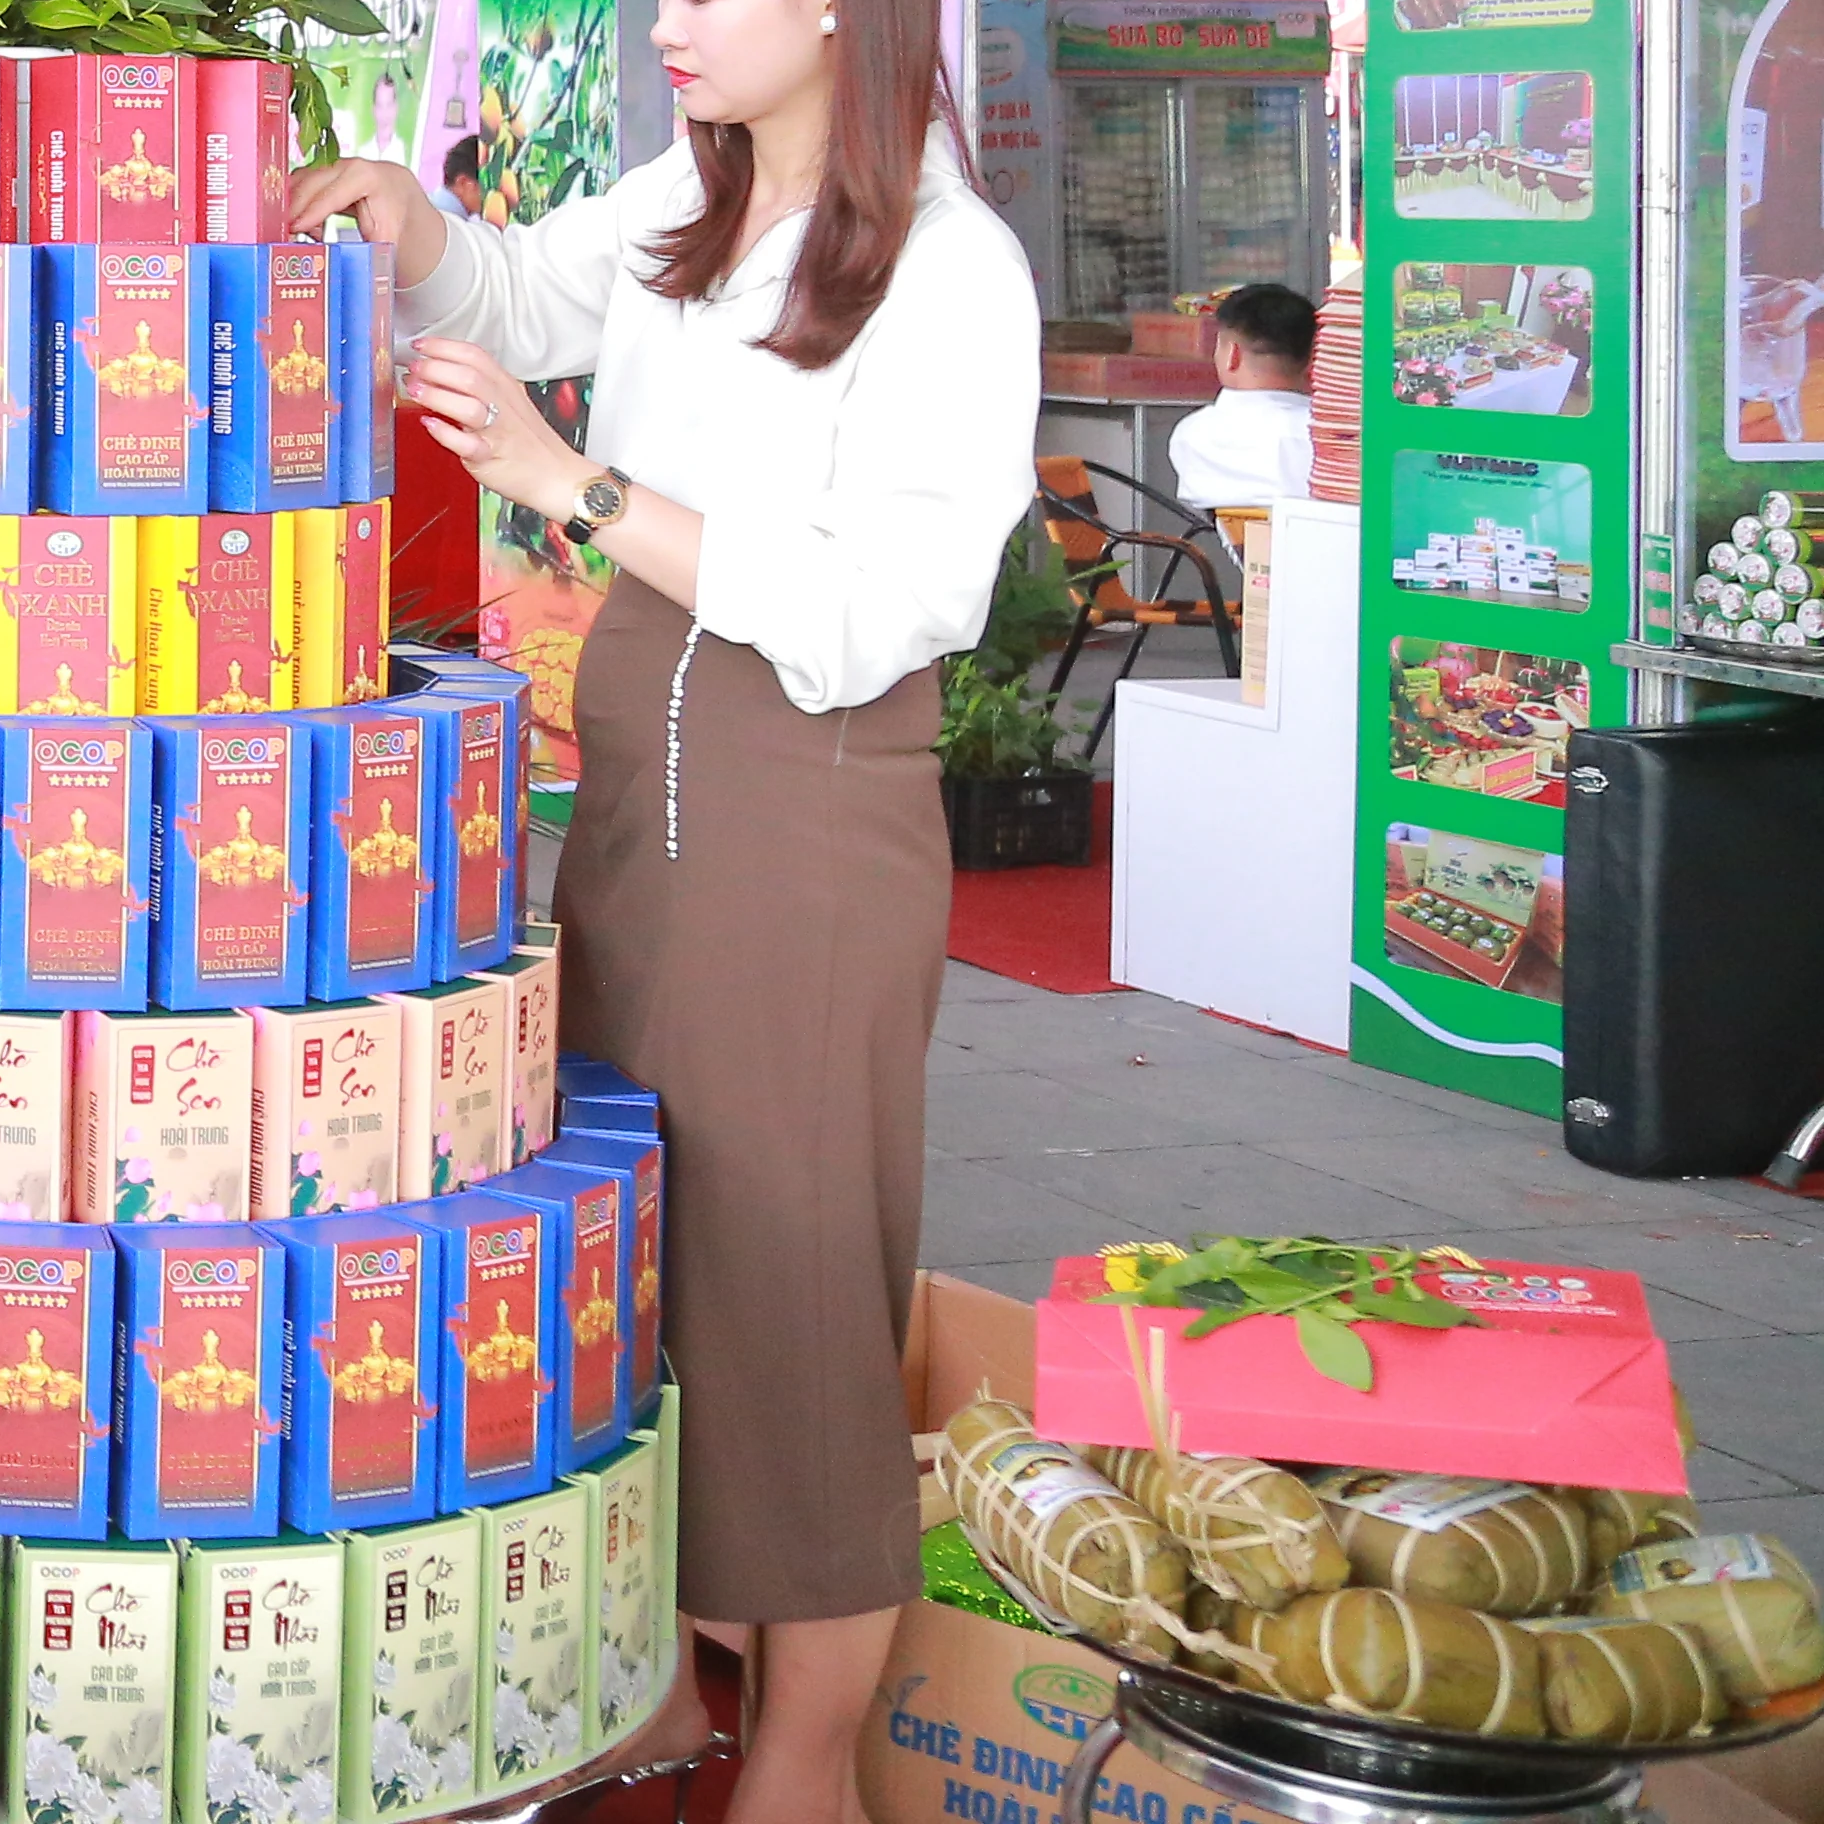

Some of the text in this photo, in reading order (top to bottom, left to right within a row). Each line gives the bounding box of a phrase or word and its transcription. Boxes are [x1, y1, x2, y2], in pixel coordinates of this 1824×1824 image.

[104, 65, 173, 88] OCOP
[206, 134, 234, 242] CHÈ HOÀI TRUNG
[102, 254, 183, 279] OCOP
[273, 254, 324, 278] OCOP
[34, 559, 94, 587] CHÈ
[211, 554, 260, 582] CHÈ
[22, 594, 107, 617] XANH
[201, 588, 269, 613] XANH
[34, 739, 124, 765] OCOP
[204, 738, 284, 764] OCOP
[355, 729, 417, 756] OCOP
[167, 1257, 256, 1284] OCOP
[339, 1249, 417, 1278] OCOP
[1443, 1282, 1593, 1305] OCOP
[889, 1709, 961, 1765] CHÈ
